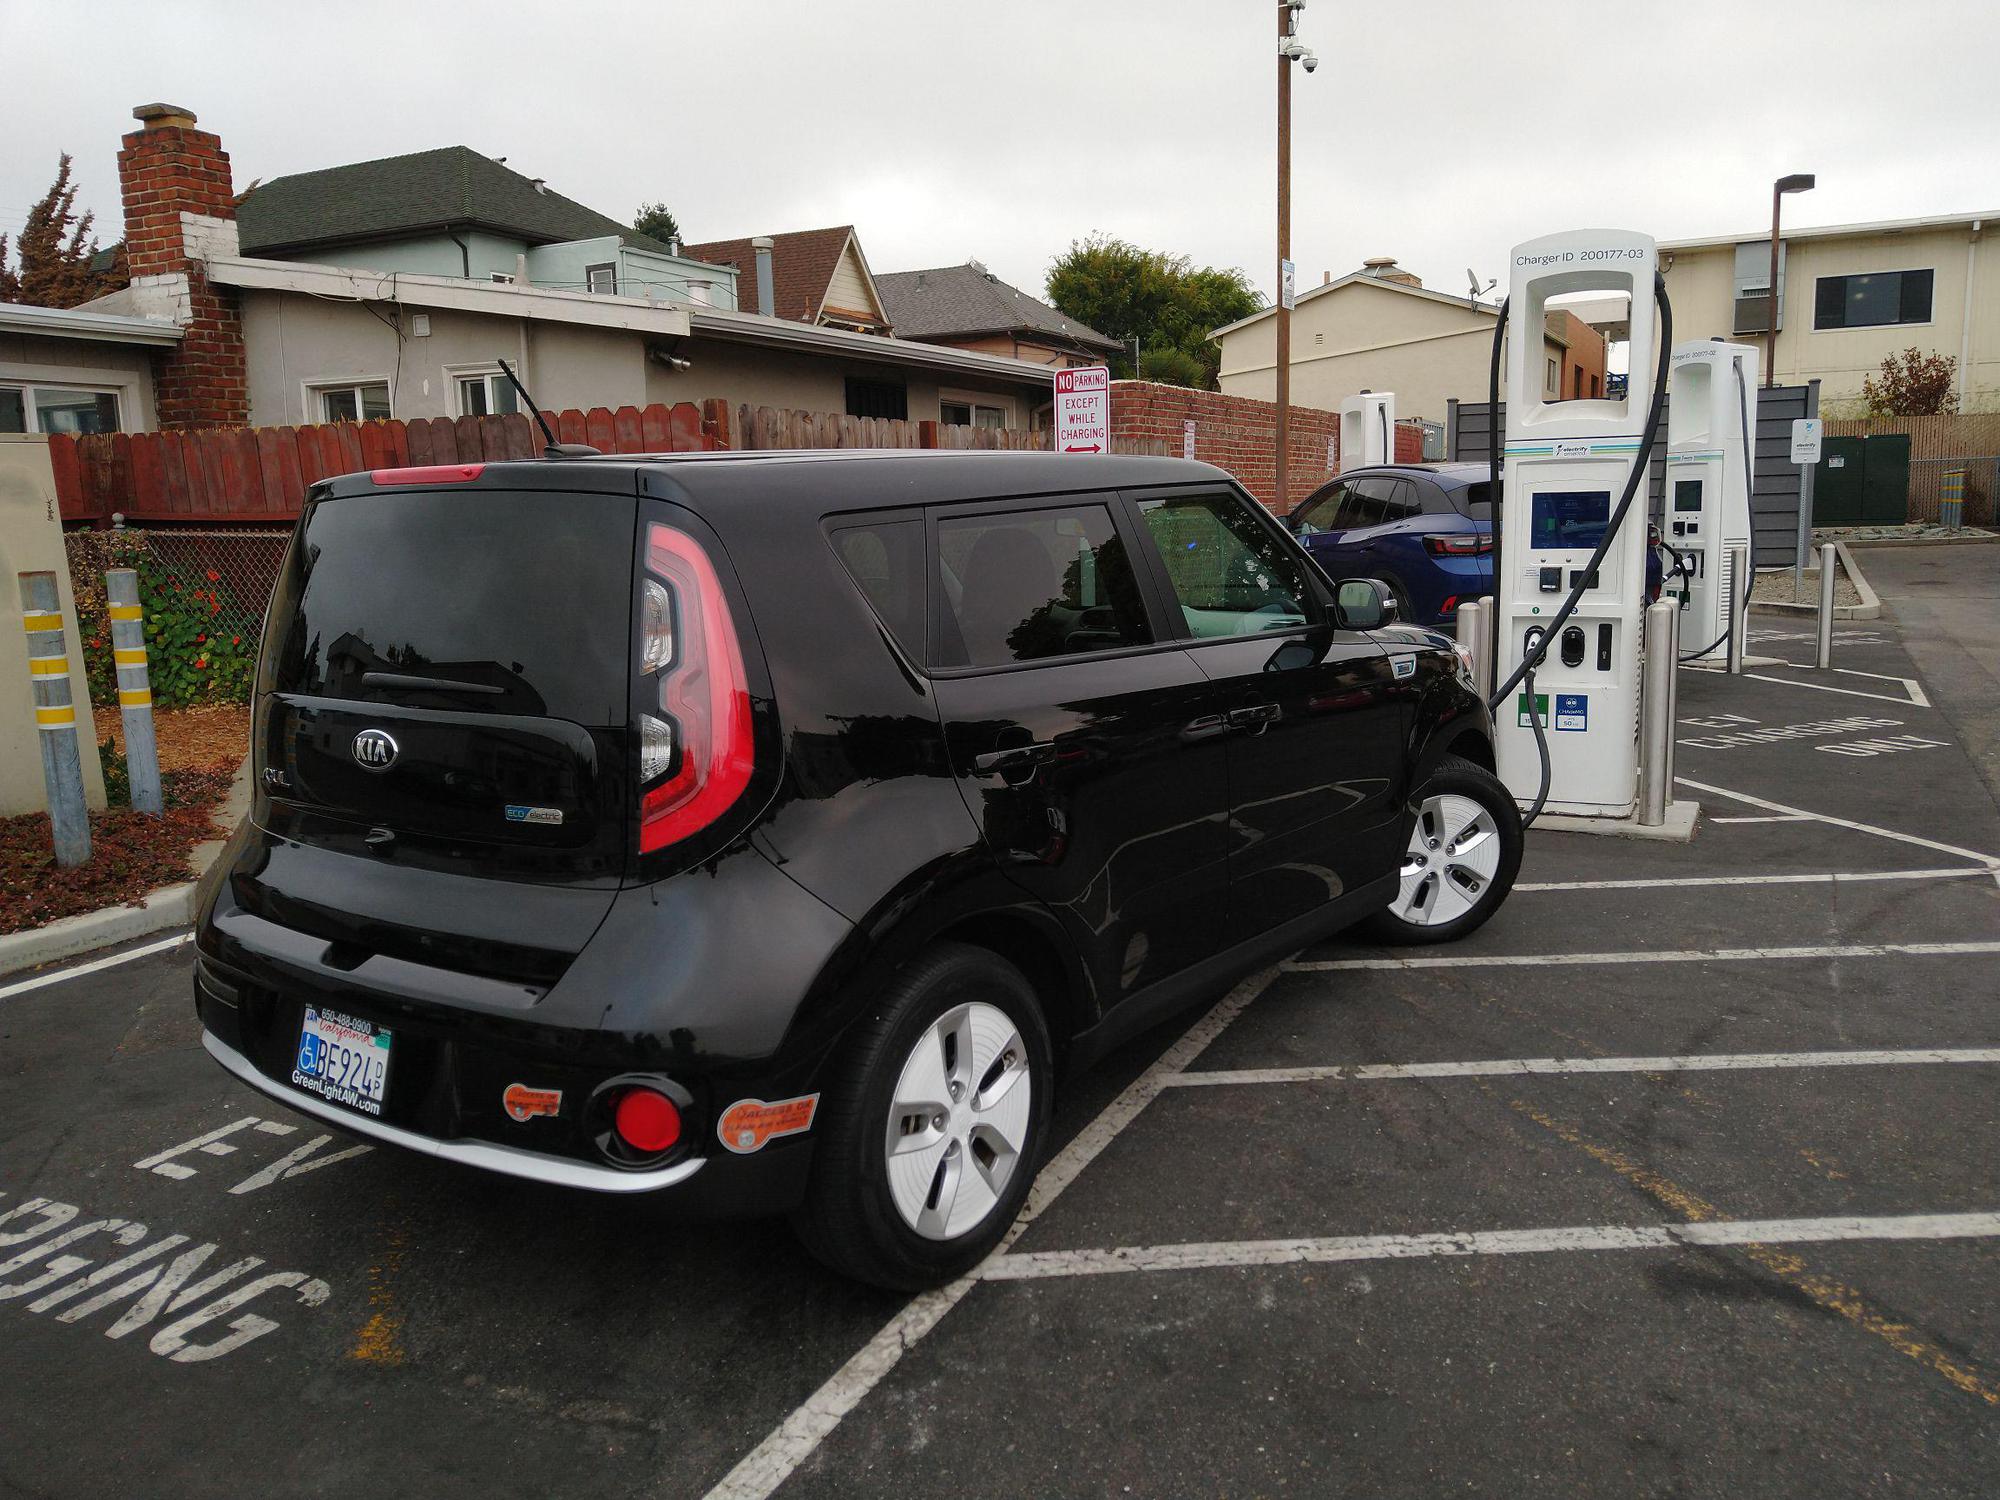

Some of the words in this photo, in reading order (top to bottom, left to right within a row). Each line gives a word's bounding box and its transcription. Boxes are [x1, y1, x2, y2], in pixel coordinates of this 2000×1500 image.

[1516, 255, 1561, 266] Charger
[1562, 252, 1574, 262] ID
[1580, 249, 1644, 261] 200177-03
[1059, 374, 1073, 390] NO
[1074, 373, 1105, 387] PARKING
[1065, 397, 1099, 410] EXCEPT
[1068, 413, 1096, 425] WHILE
[1061, 427, 1105, 441] CHARGING
[1676, 714, 1761, 729] EV
[1675, 716, 1905, 750] CHARGING
[356, 737, 388, 763] KIA
[1814, 734, 1952, 758] ONLY
[507, 809, 525, 818] ECO
[529, 812, 561, 820] electric
[319, 1019, 376, 1048] California
[315, 1038, 372, 1096] BE924
[291, 1069, 380, 1116] GreenLightAW.com
[133, 1116, 376, 1195] EV
